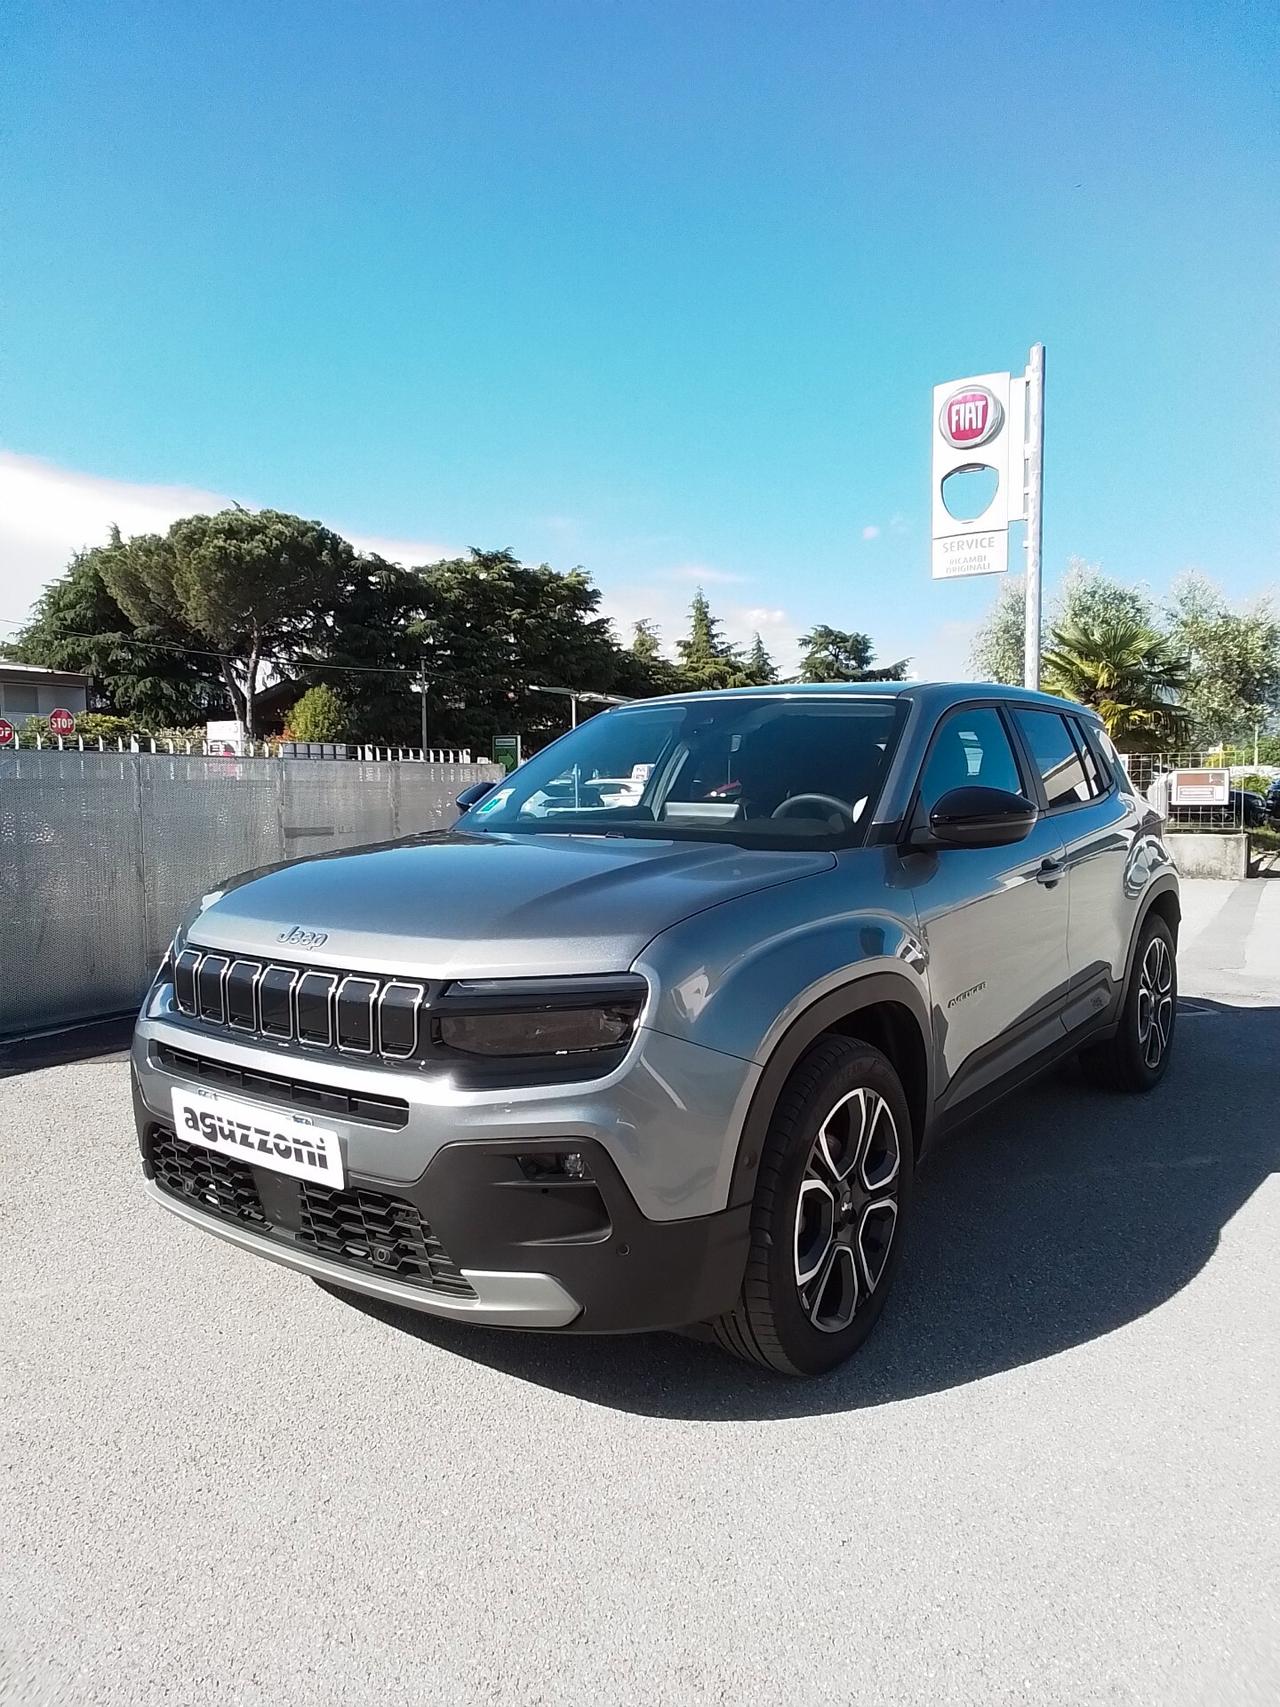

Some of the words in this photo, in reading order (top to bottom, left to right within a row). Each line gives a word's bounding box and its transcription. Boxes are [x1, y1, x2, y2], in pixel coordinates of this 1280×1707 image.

[951, 400, 987, 433] FIAT
[942, 536, 996, 554] SERVICE
[948, 554, 988, 566] RICAMBI
[945, 562, 991, 575] ORIGINALI
[51, 717, 74, 729] STOP
[0, 727, 11, 737] OP
[277, 925, 329, 952] Jeep
[183, 1106, 329, 1170] aguzzoni
